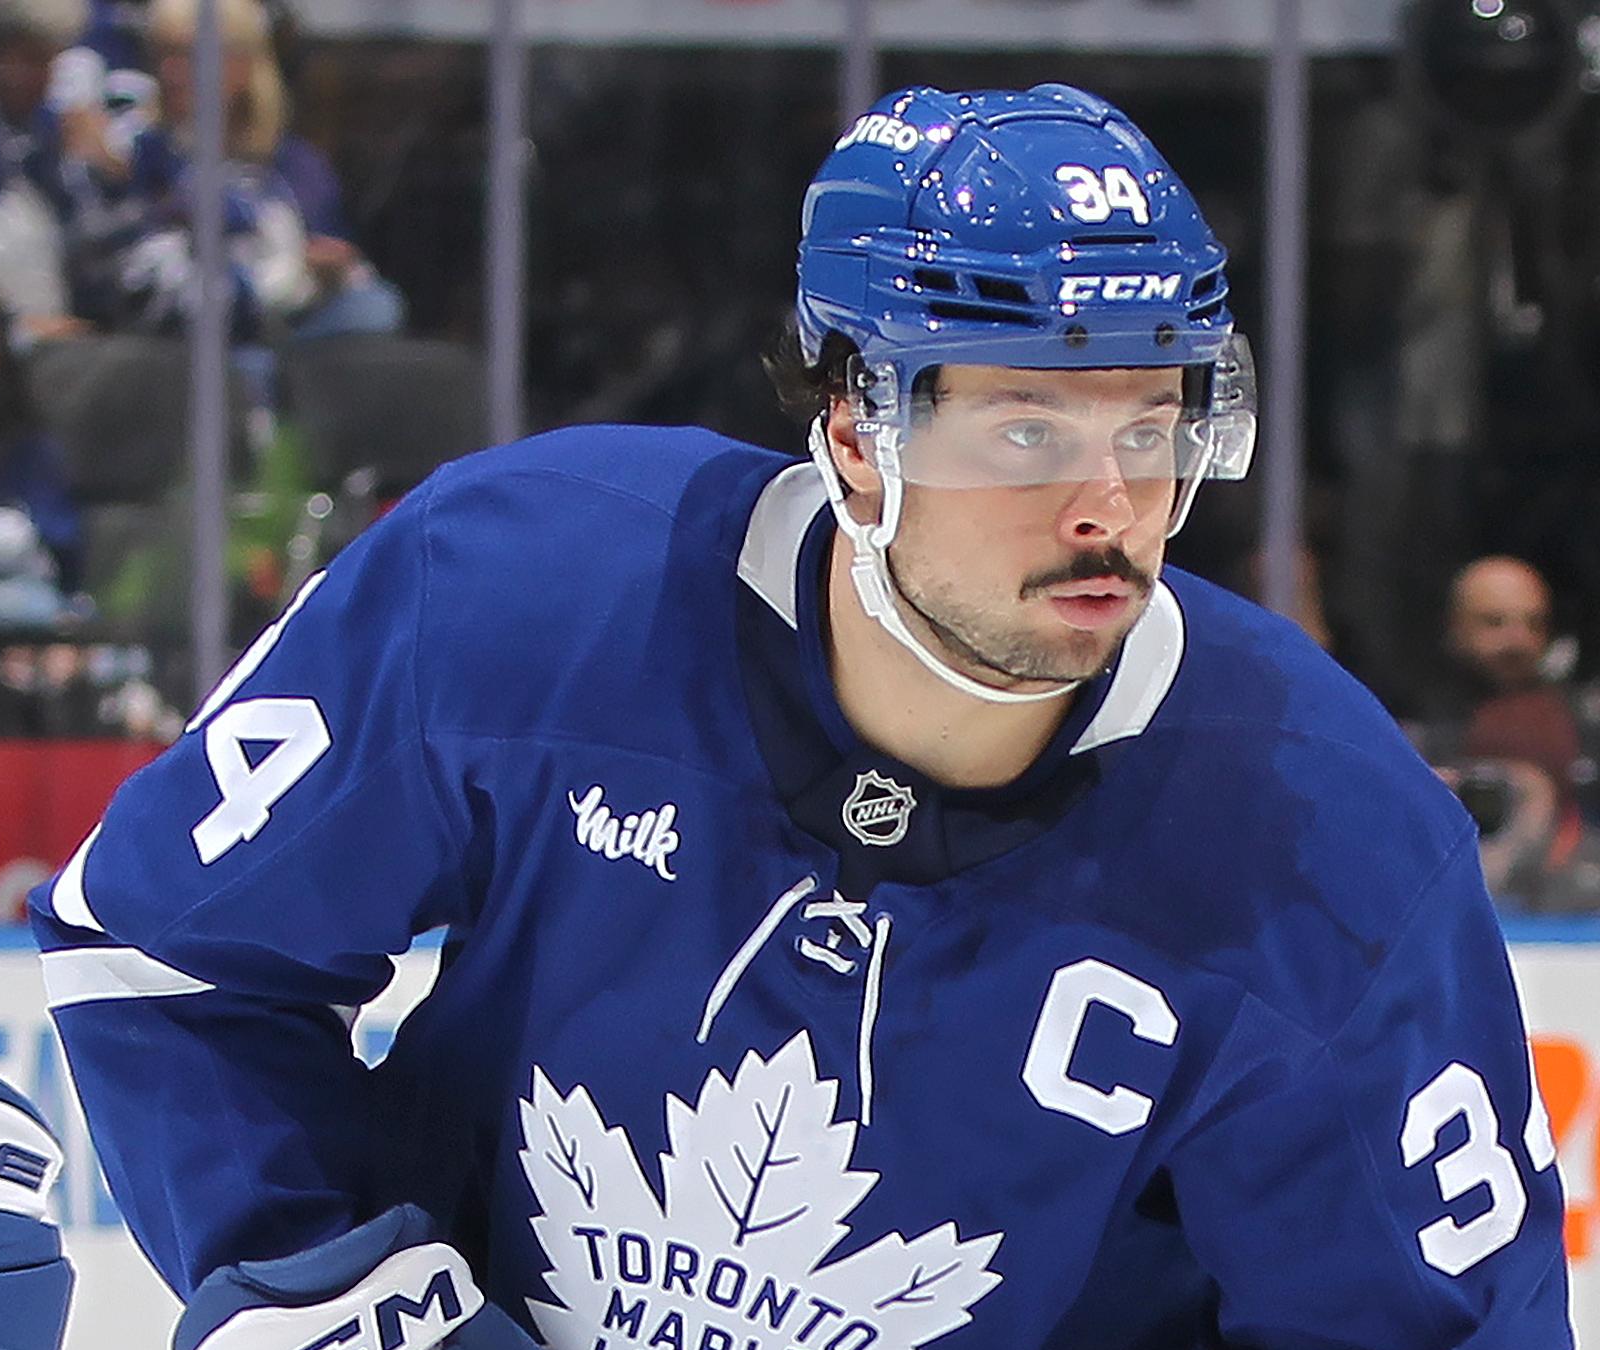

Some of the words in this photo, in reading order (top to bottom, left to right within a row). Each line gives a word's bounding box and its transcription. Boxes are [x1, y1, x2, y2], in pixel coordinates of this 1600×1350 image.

[1055, 163, 1151, 226] 34
[1058, 274, 1183, 301] CCM
[1023, 958, 1180, 1135] C
